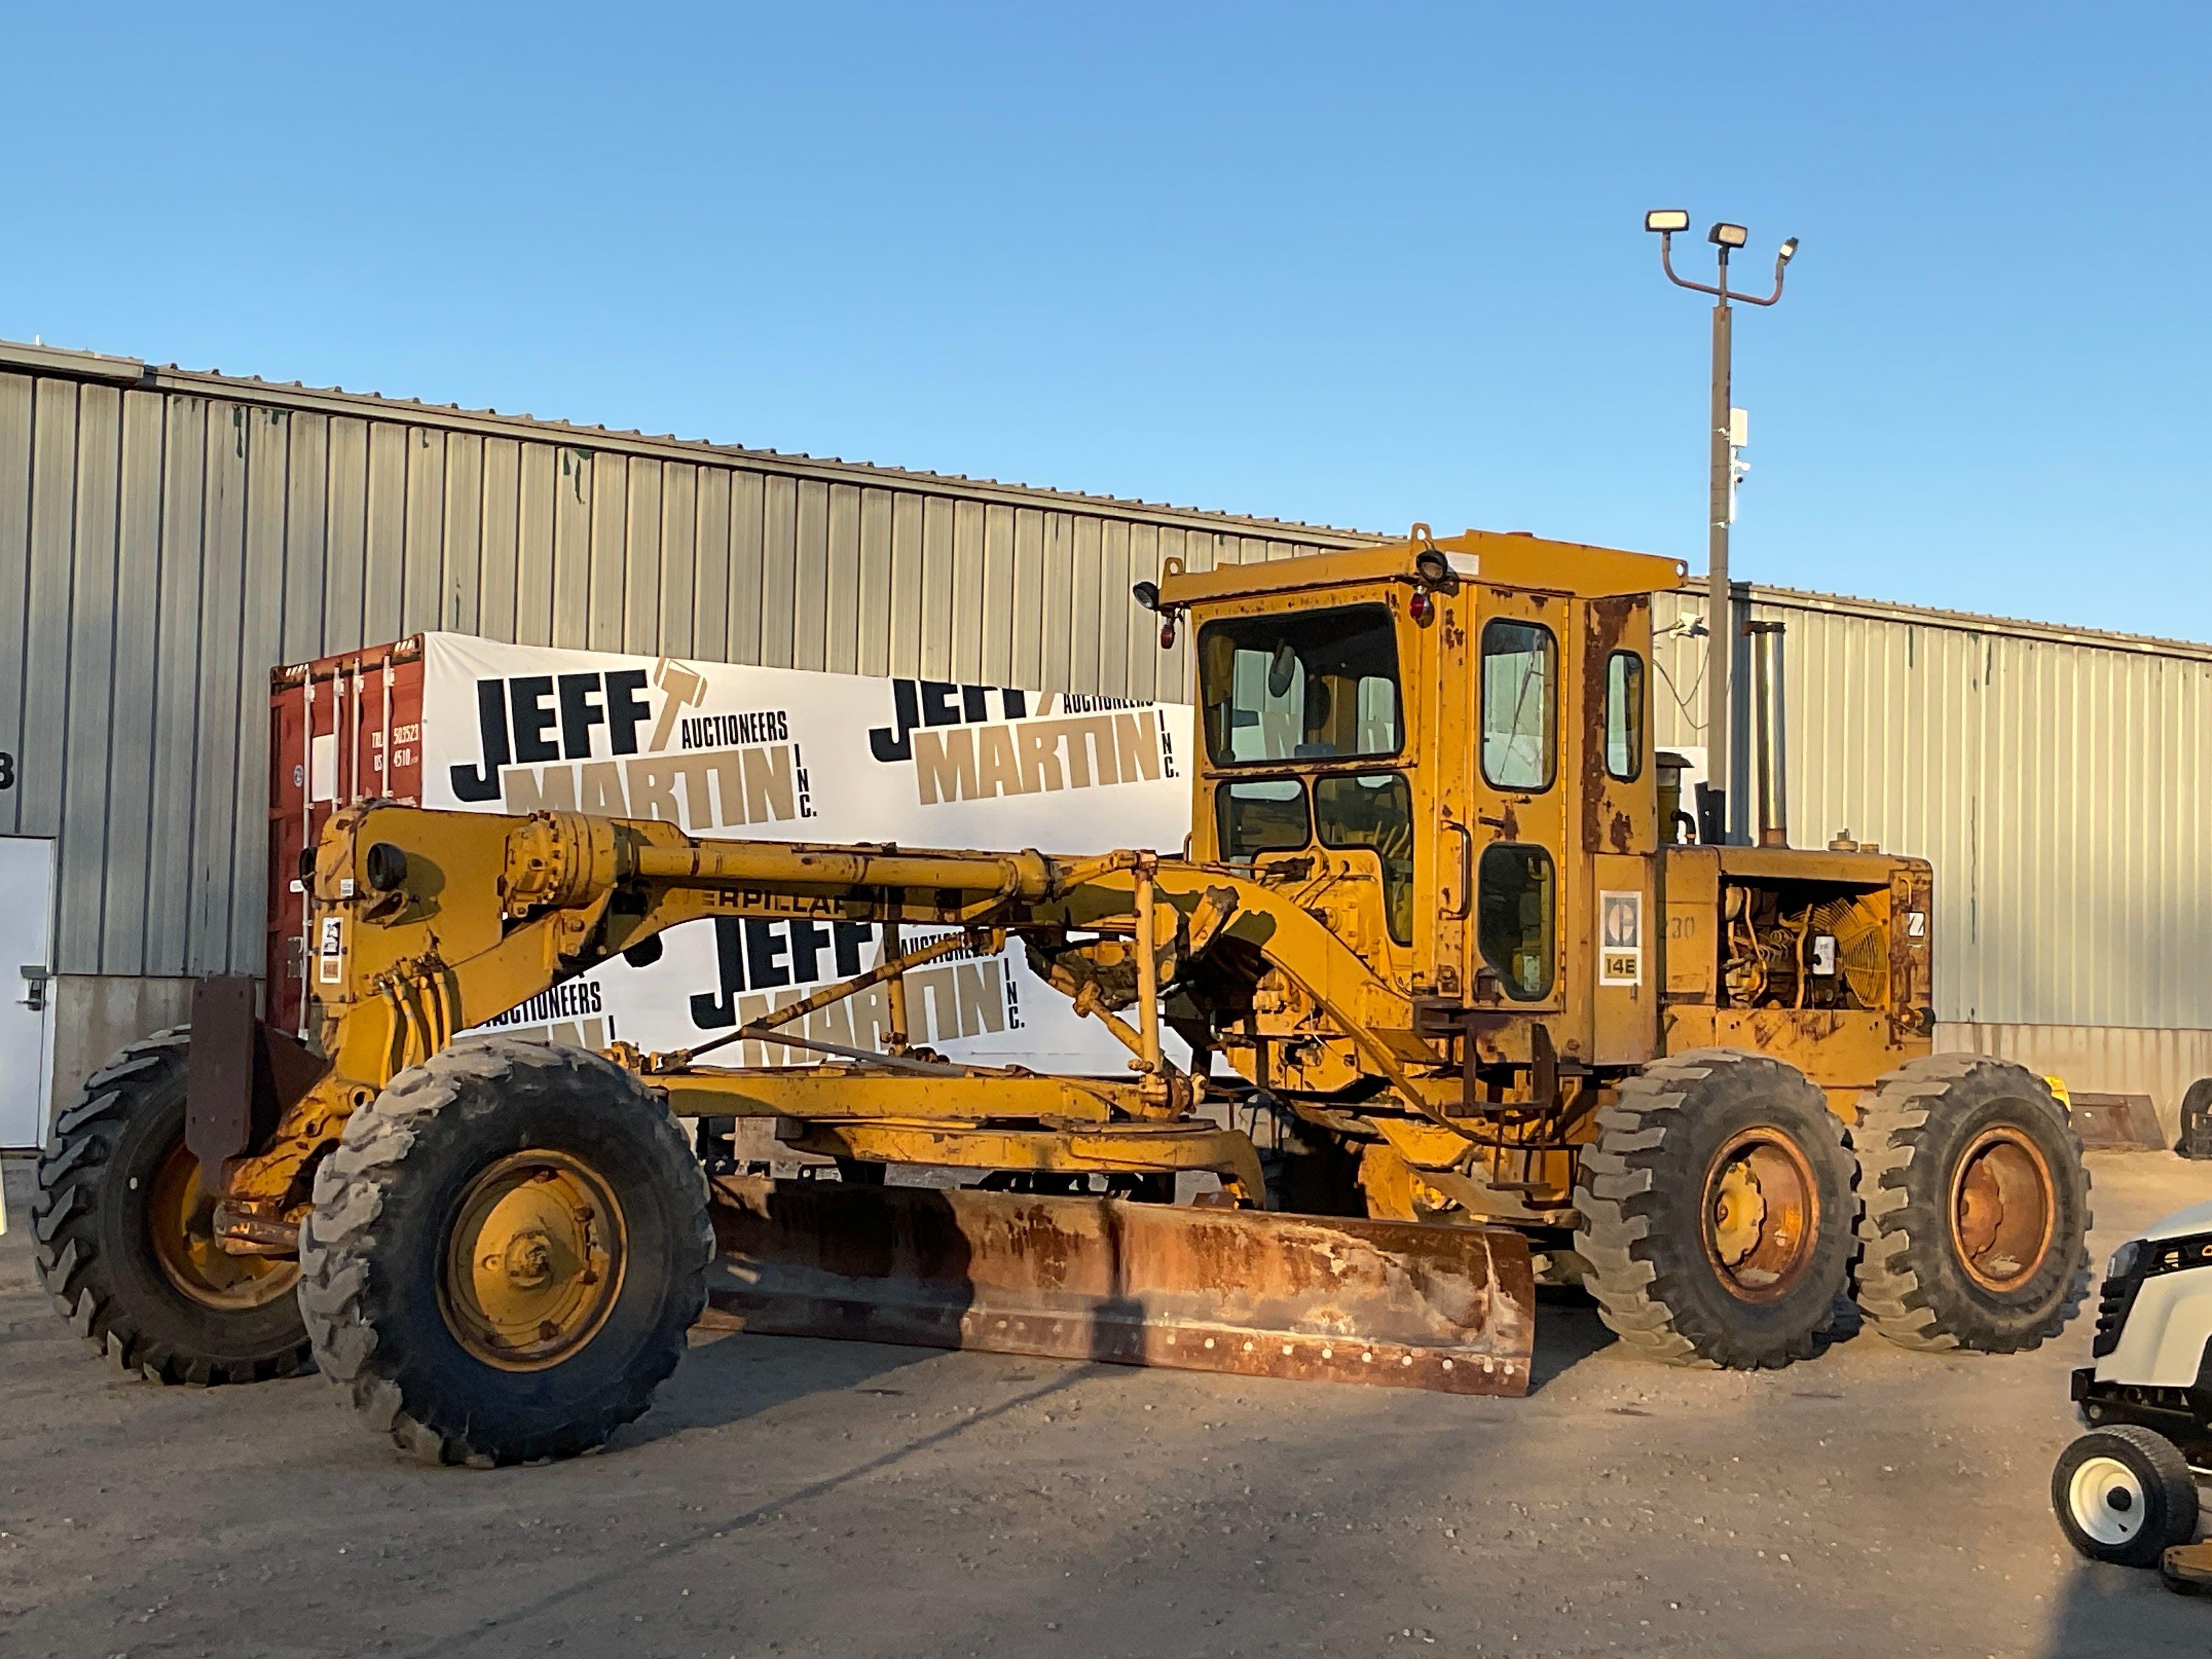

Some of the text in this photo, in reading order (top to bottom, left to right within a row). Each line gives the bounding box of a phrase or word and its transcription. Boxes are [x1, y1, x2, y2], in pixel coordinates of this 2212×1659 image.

[450, 668, 652, 803] JEFF
[681, 710, 789, 750] AUCTIONEERS
[913, 711, 1161, 805] MARTIN
[1158, 709, 1180, 778] INC.
[503, 744, 797, 831] MARTIN
[794, 743, 817, 819] INC.
[690, 916, 873, 1030] JEFF
[1003, 957, 1025, 1029] INC.
[1606, 958, 1636, 974] 14E
[486, 981, 602, 1028] CTIONEERS
